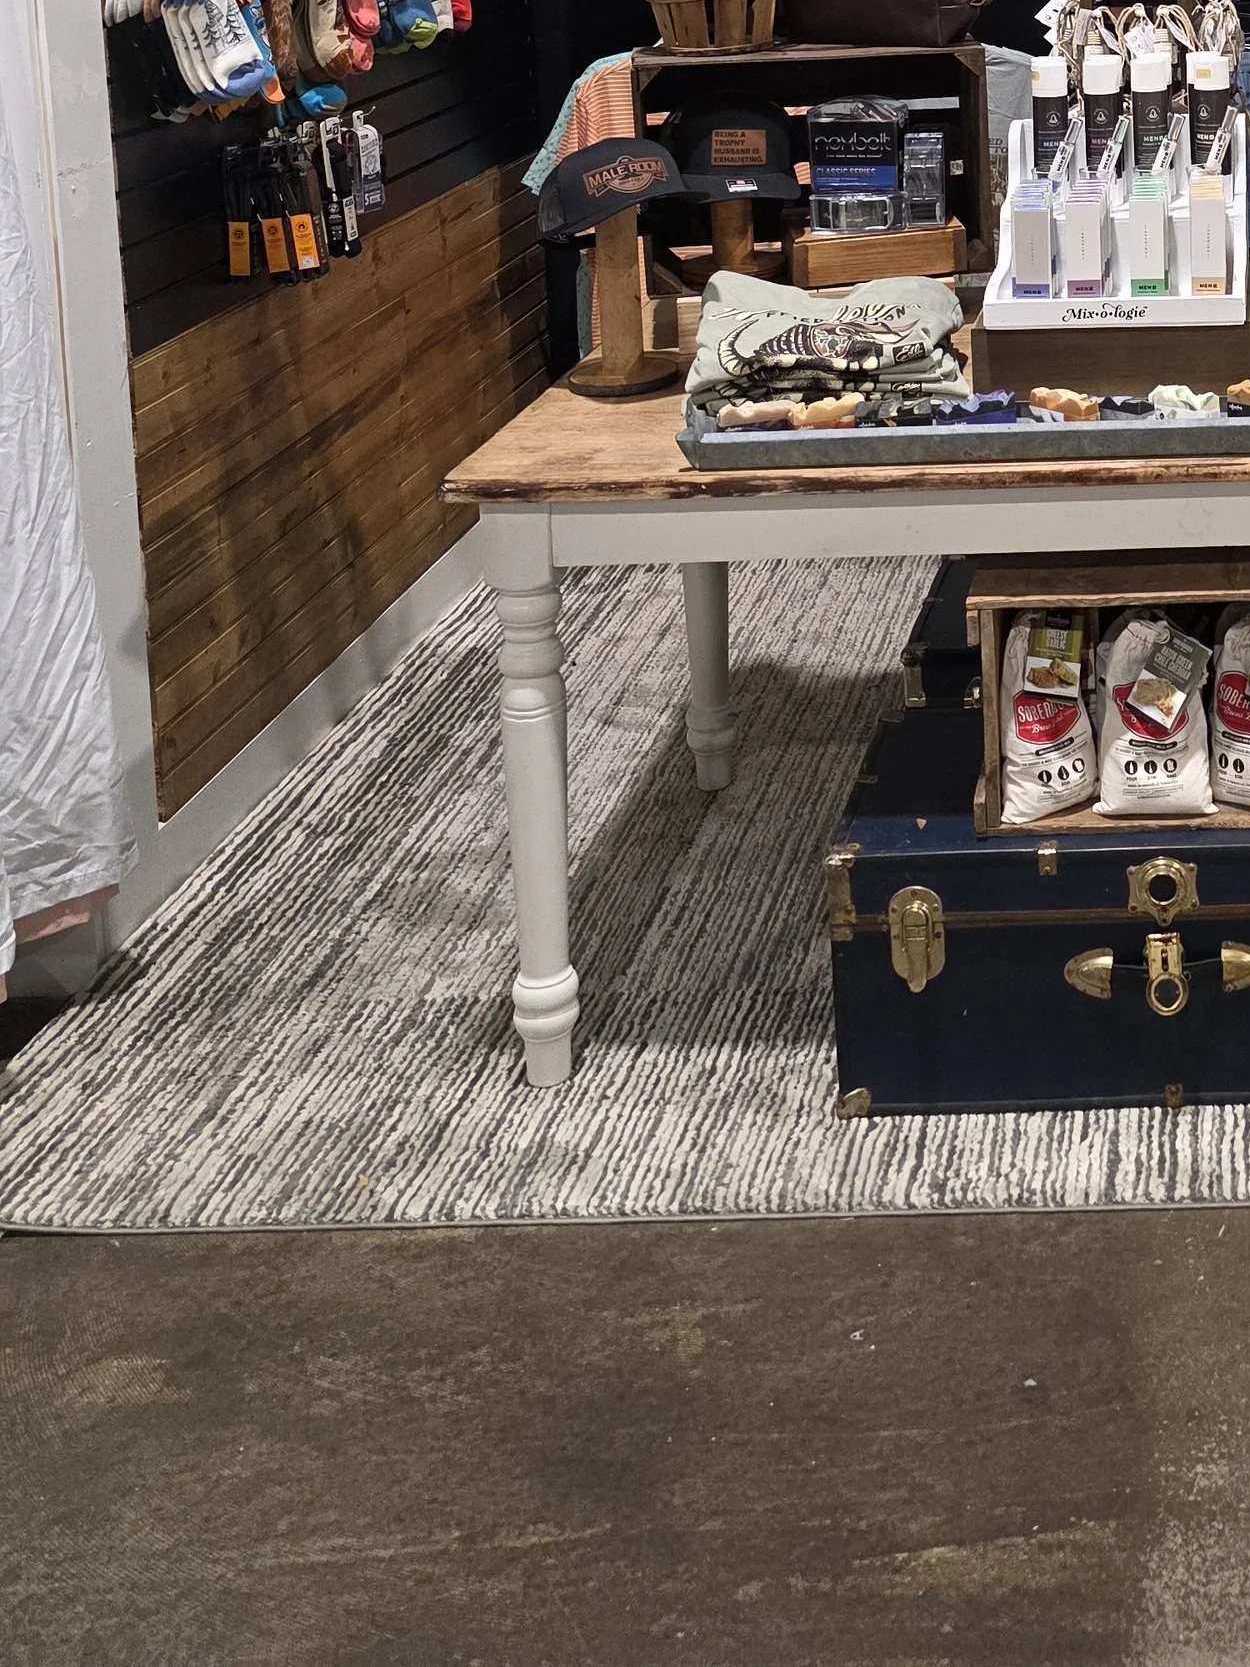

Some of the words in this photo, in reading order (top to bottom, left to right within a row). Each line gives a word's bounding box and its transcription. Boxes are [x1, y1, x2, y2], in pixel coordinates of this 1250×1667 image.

[814, 132, 892, 151] nexbelt
[713, 156, 764, 164] EXHAUSTING.
[588, 165, 630, 188] MALE
[629, 161, 662, 173] ROOM
[816, 167, 848, 176] CLASSIC
[849, 167, 876, 176] SERIES
